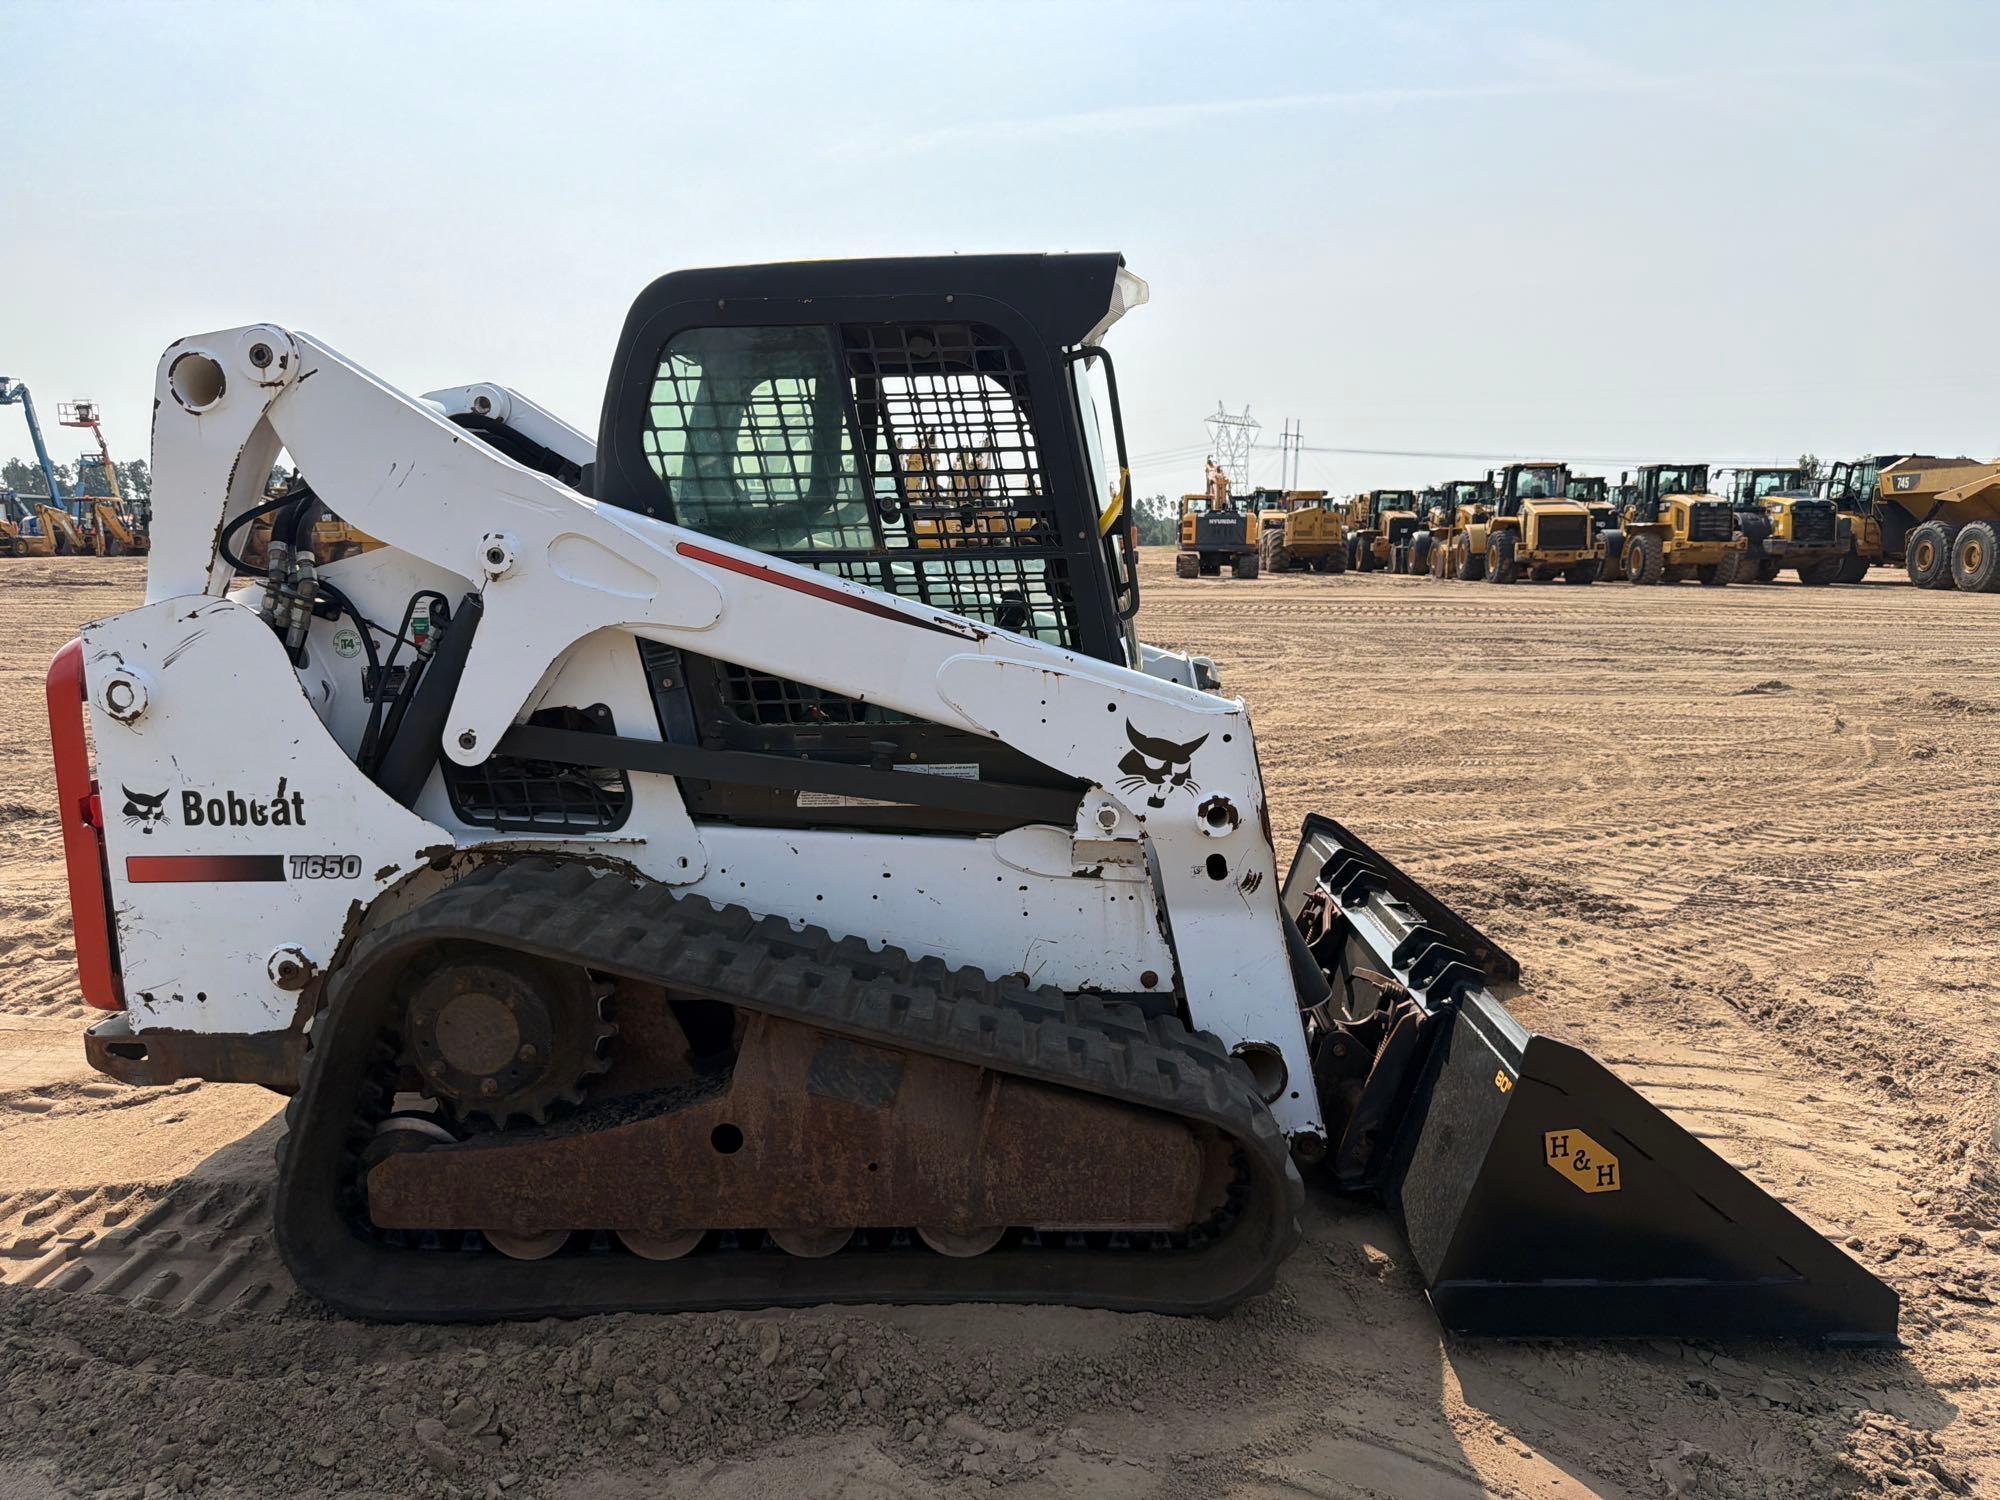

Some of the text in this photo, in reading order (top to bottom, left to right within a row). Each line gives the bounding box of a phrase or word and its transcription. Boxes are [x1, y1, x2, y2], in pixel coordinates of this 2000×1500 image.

[1897, 476, 1910, 489] 745
[181, 790, 307, 827] Bobcat
[289, 854, 362, 881] T650
[1550, 1135, 1616, 1187] H & H
